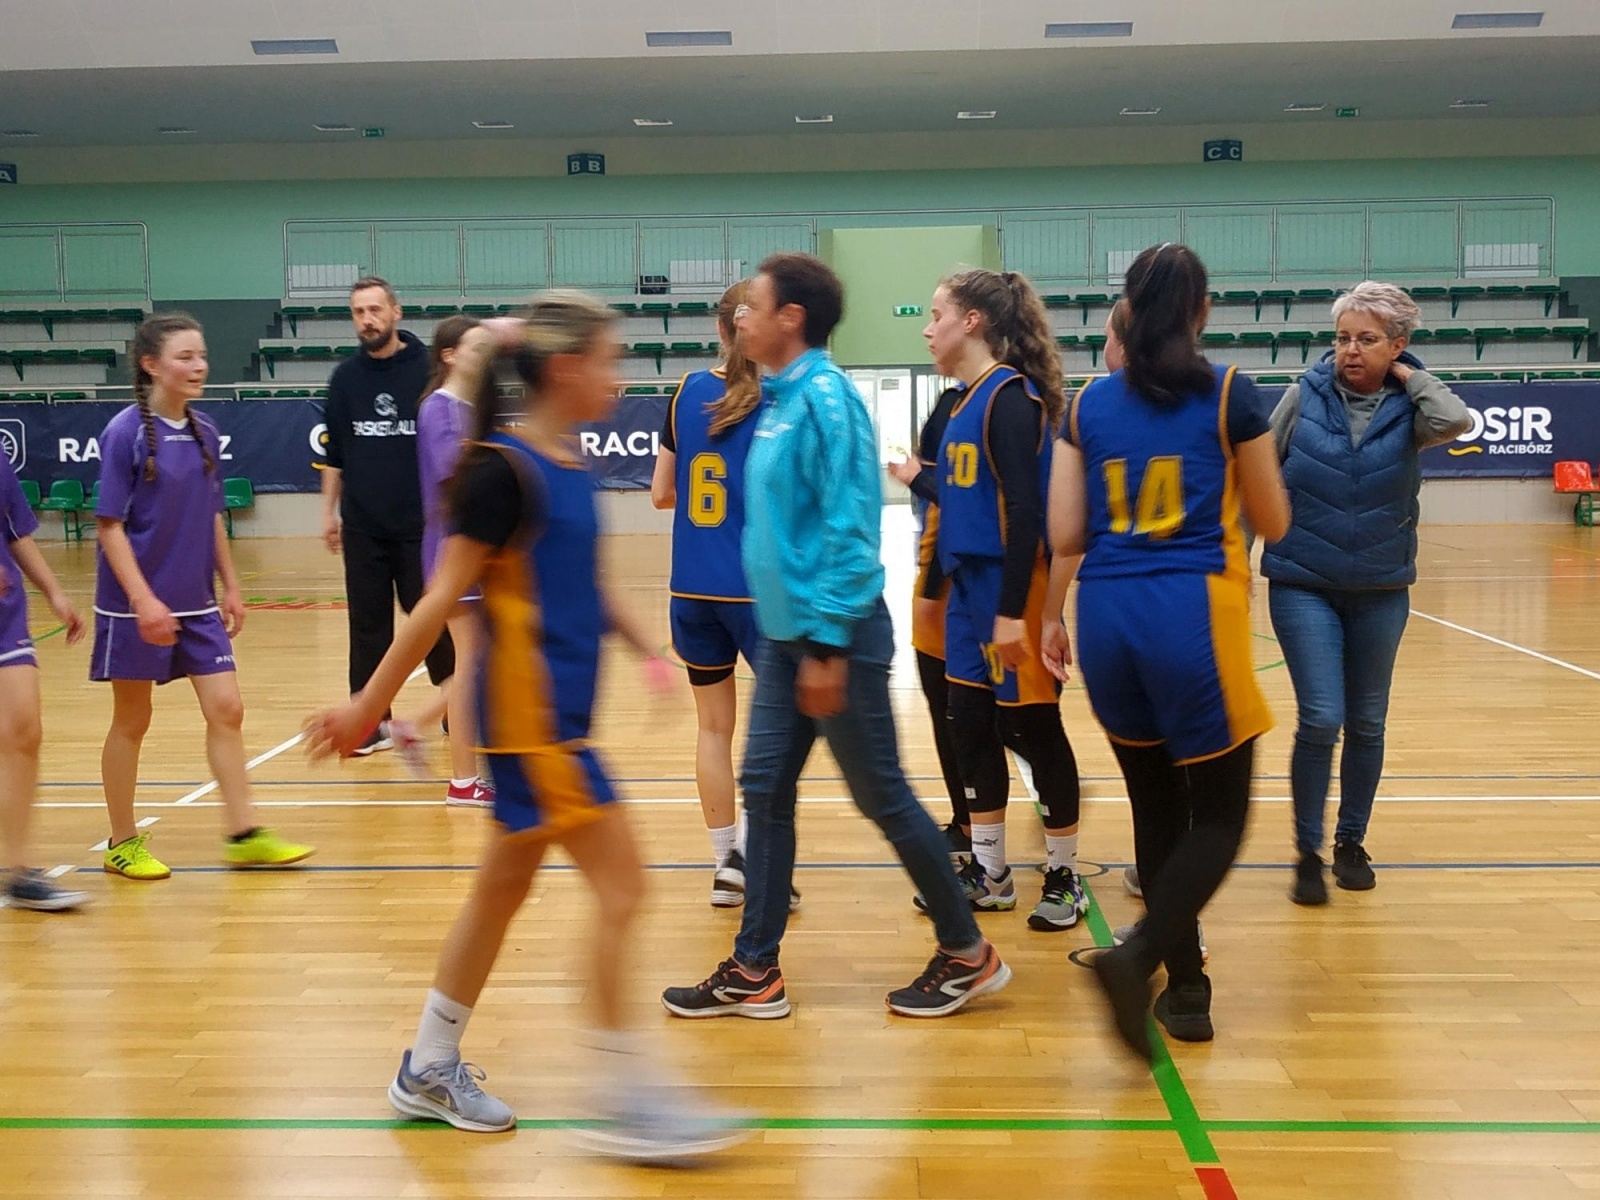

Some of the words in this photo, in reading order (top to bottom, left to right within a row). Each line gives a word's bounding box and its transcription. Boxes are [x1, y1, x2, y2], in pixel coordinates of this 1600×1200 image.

[1207, 147, 1222, 159] C
[1229, 146, 1240, 158] C
[571, 160, 580, 172] B
[588, 160, 601, 171] B
[580, 431, 659, 457] RACI
[1488, 442, 1553, 455] RACIBÓRZ
[688, 452, 728, 528] 6
[1102, 455, 1186, 541] 14
